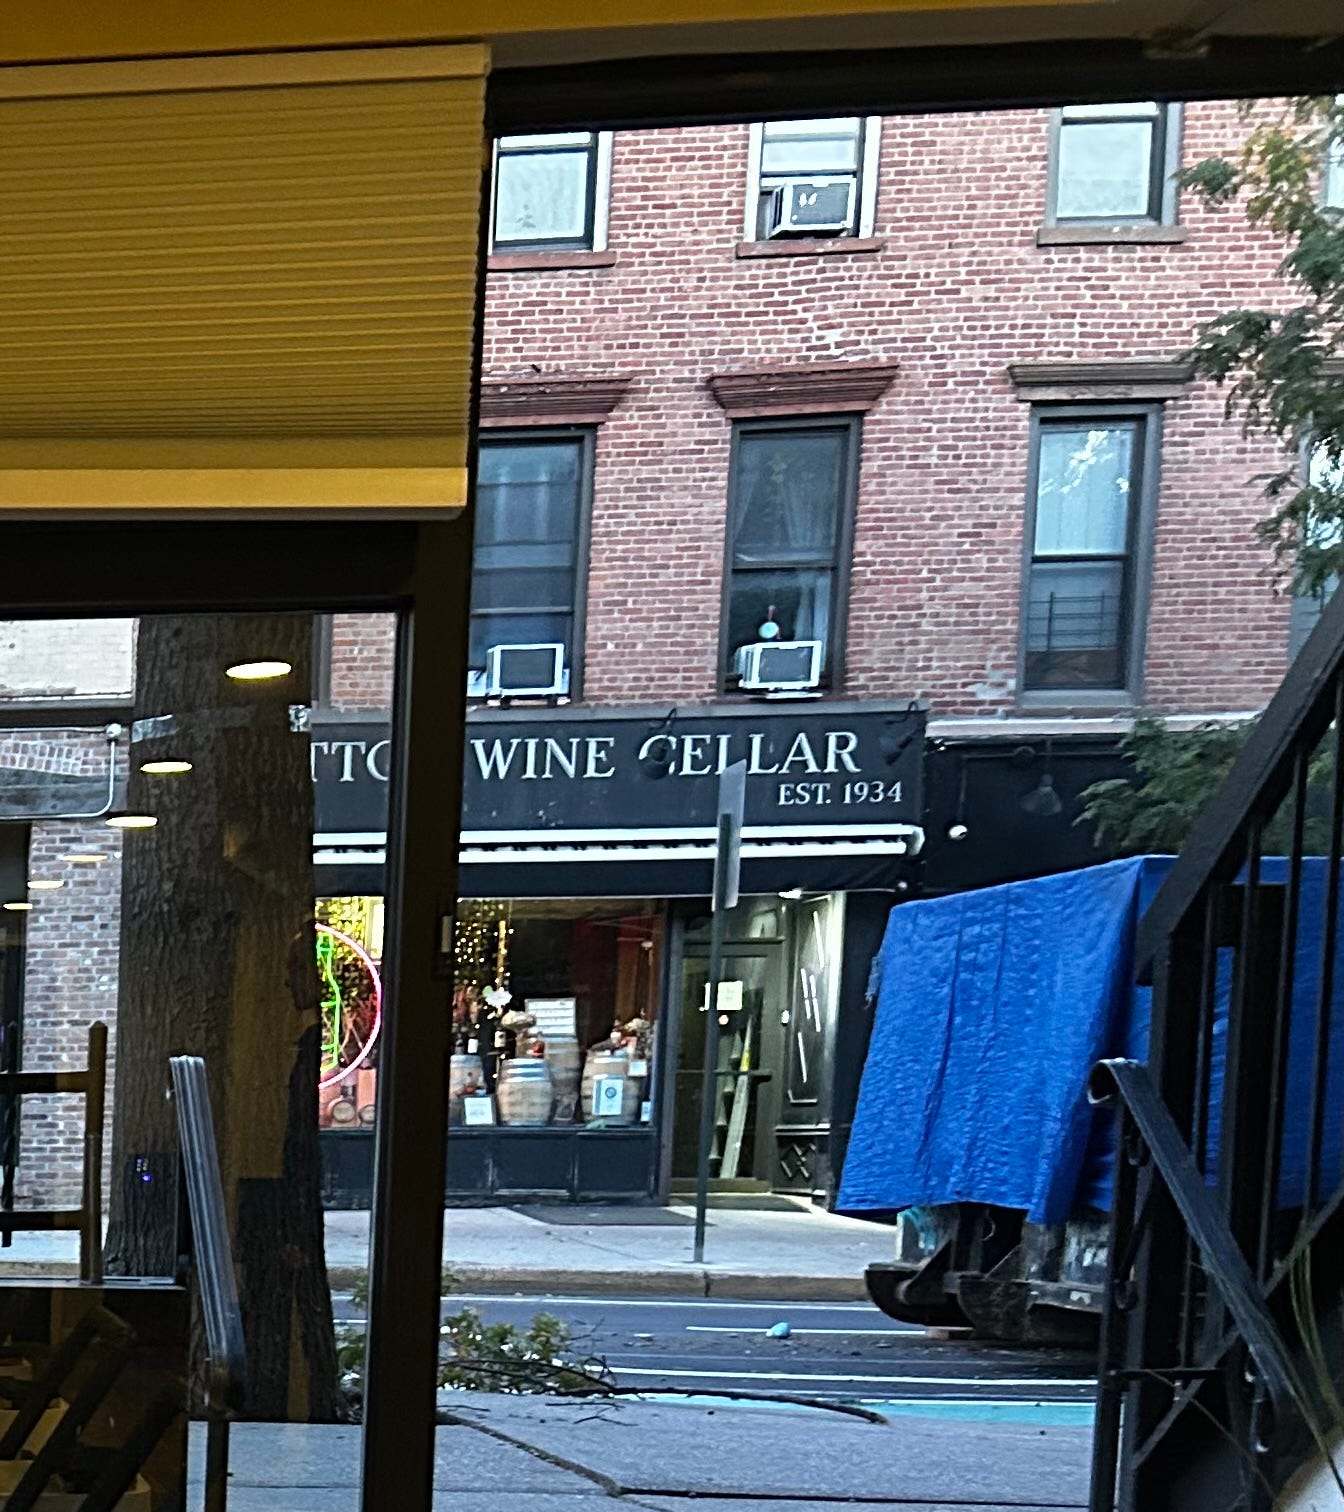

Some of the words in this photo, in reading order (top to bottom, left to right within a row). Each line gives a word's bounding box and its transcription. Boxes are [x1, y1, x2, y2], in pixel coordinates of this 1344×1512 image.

[470, 736, 616, 781] WINE
[638, 731, 862, 777] CELLAR
[778, 782, 832, 806] EST.
[842, 780, 903, 804] 1934
